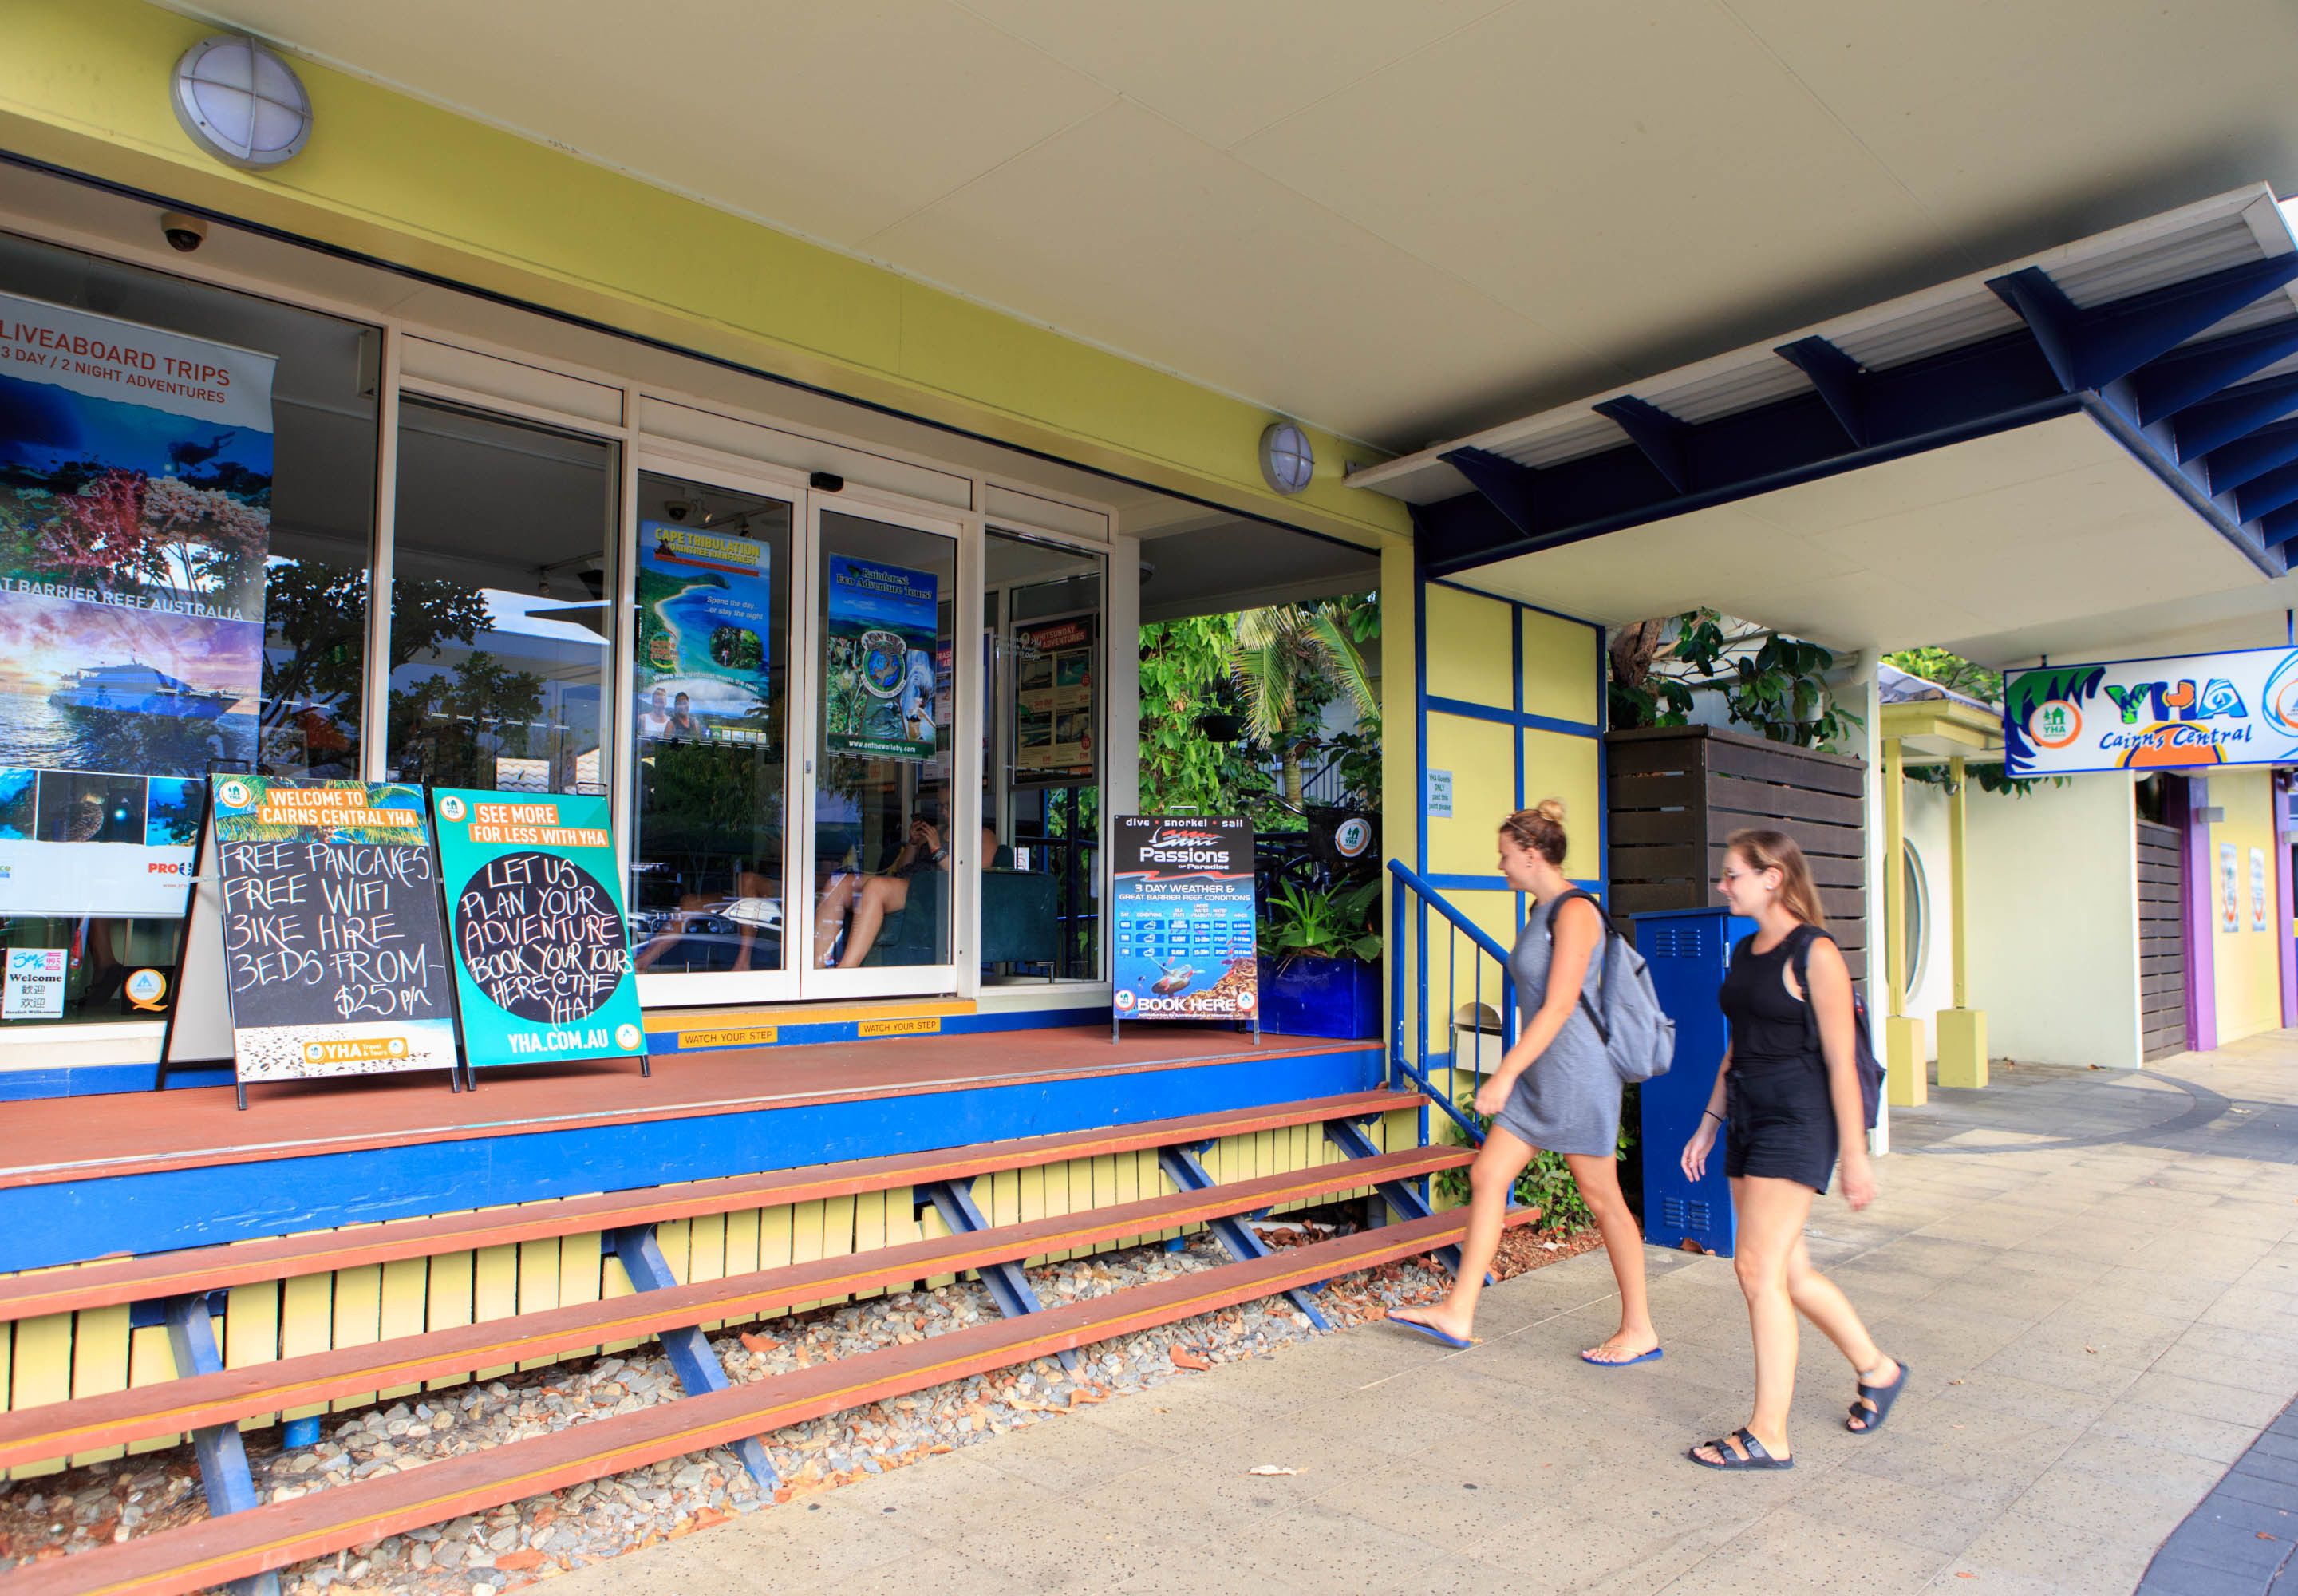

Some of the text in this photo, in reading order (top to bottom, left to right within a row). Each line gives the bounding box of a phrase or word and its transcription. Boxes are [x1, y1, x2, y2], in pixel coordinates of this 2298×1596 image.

[0, 321, 231, 387] LIVEABOARD TRIPS
[2, 346, 10, 358] 3
[15, 348, 46, 365] DAY
[61, 358, 69, 371] 2
[76, 364, 121, 382] NIGHT
[127, 373, 225, 404] ADVENTURES
[655, 528, 760, 558] CAPE TRIBULATION
[836, 573, 854, 586] Eco
[857, 578, 903, 595] Adventure
[904, 587, 932, 599] Tours!
[862, 568, 909, 585] Rainforest
[18, 581, 97, 602] BARRIER
[103, 591, 147, 609] REEF
[152, 598, 243, 621] AUSTRALIA
[707, 596, 728, 606] Spend
[718, 608, 732, 617] stay
[733, 609, 745, 618] the
[746, 611, 763, 620] night
[1033, 625, 1076, 641] WHITSUNDAY
[1043, 631, 1085, 648] ADVENTURES
[653, 673, 673, 681] Where
[2103, 678, 2249, 725] YHA
[849, 739, 915, 754] www.onthewallaby.com
[2099, 724, 2253, 750] Cairns Central
[270, 789, 363, 807] WELCOME TO
[263, 808, 415, 826] CAIRNS CENTRAL YHA
[480, 806, 556, 824] SEE MORE
[1126, 818, 1150, 827] dive
[1222, 819, 1243, 828] sail
[474, 827, 606, 846] FOR LESS WITH YHA
[219, 841, 431, 887] FREE PANCAKES
[1140, 847, 1230, 863] Passions
[487, 855, 579, 890] LET US
[223, 873, 390, 918] FREE WIFI
[461, 885, 613, 919] PLAN YOUR
[319, 913, 405, 950] HIRE
[465, 914, 620, 960] ADVENTURE
[468, 942, 634, 984] BOOK YOUR TOURS
[334, 983, 397, 1020] $25
[492, 974, 550, 1011] HERE
[543, 995, 596, 1032] YHA!
[1138, 998, 1236, 1012] BOOK HERE
[685, 1030, 772, 1044] WATCH YOUR STEP
[863, 1021, 937, 1034] WATCH YOUR STEP
[325, 1044, 362, 1060] YHA
[508, 1029, 609, 1053] YHA.COM.AU
